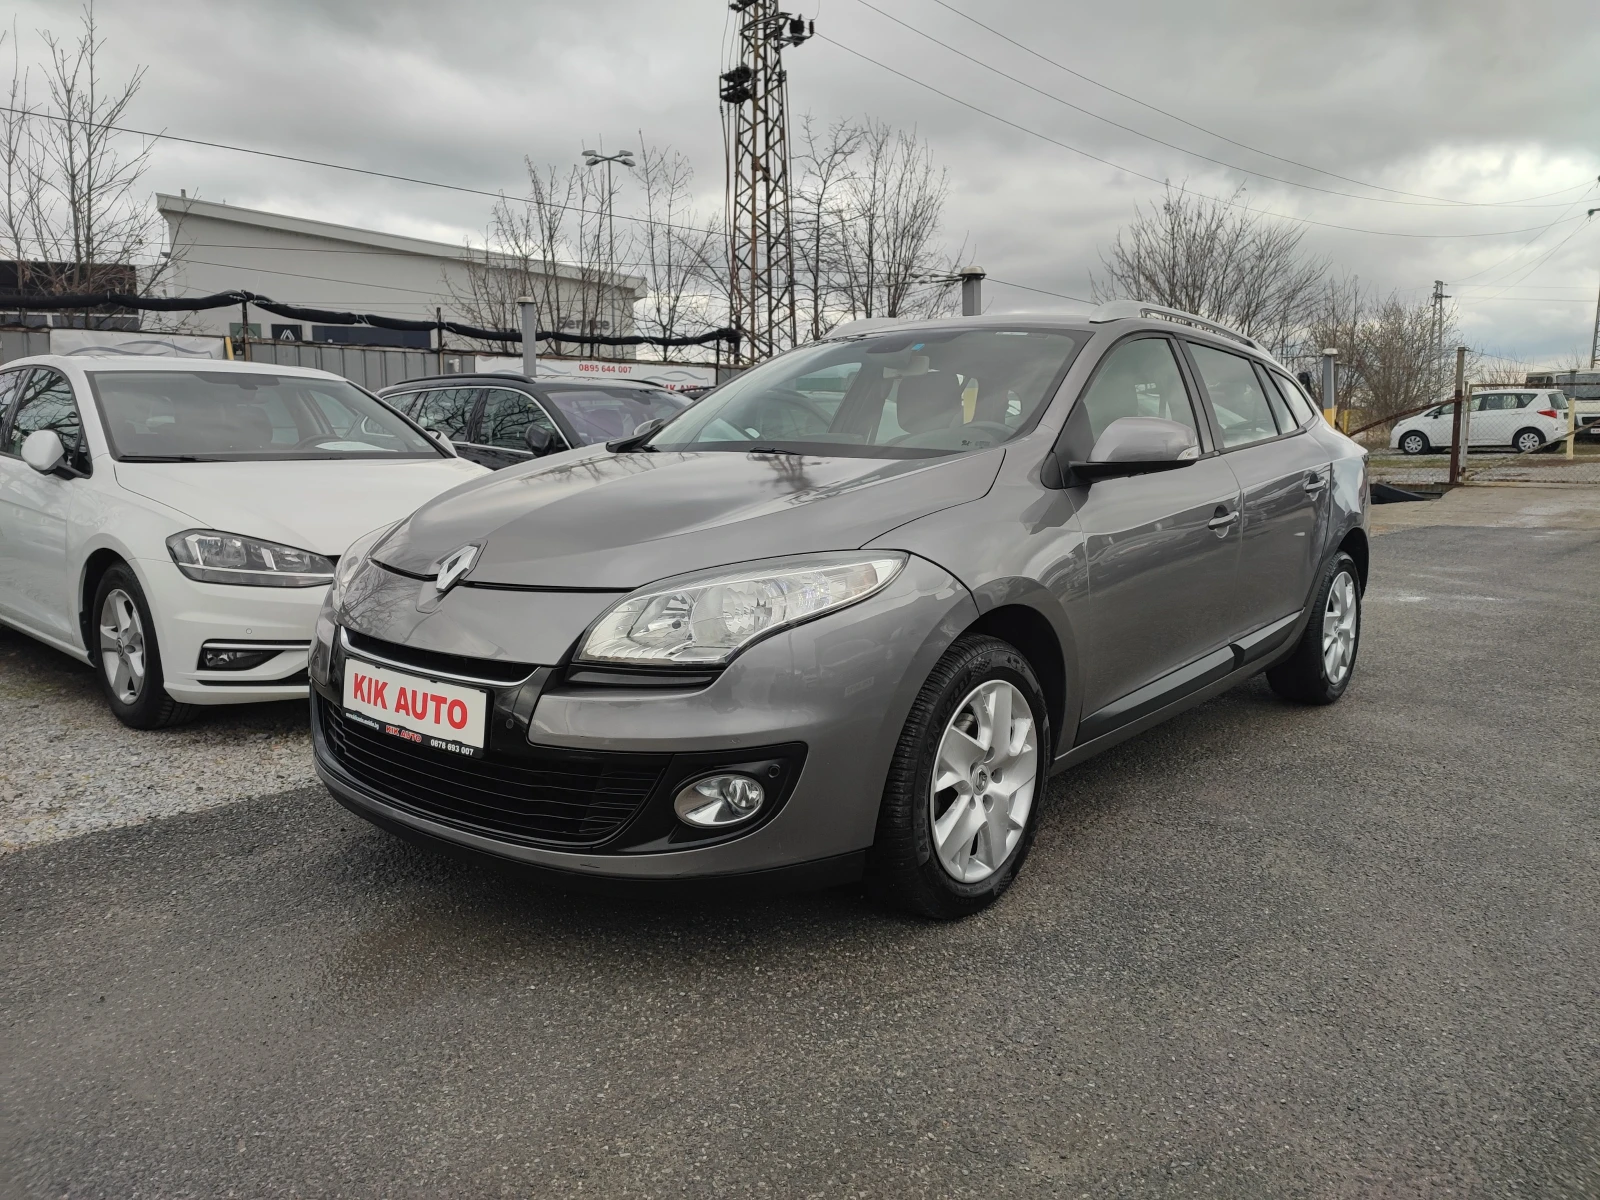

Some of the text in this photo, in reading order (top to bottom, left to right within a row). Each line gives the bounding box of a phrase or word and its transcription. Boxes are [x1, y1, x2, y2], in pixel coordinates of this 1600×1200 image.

[559, 317, 610, 330] Serce
[578, 364, 633, 374] 0895 644 007
[353, 672, 388, 710] KIK
[394, 686, 468, 730] AUTO
[385, 724, 423, 743] KIK AUTO
[430, 739, 474, 756] 0878 693 007
